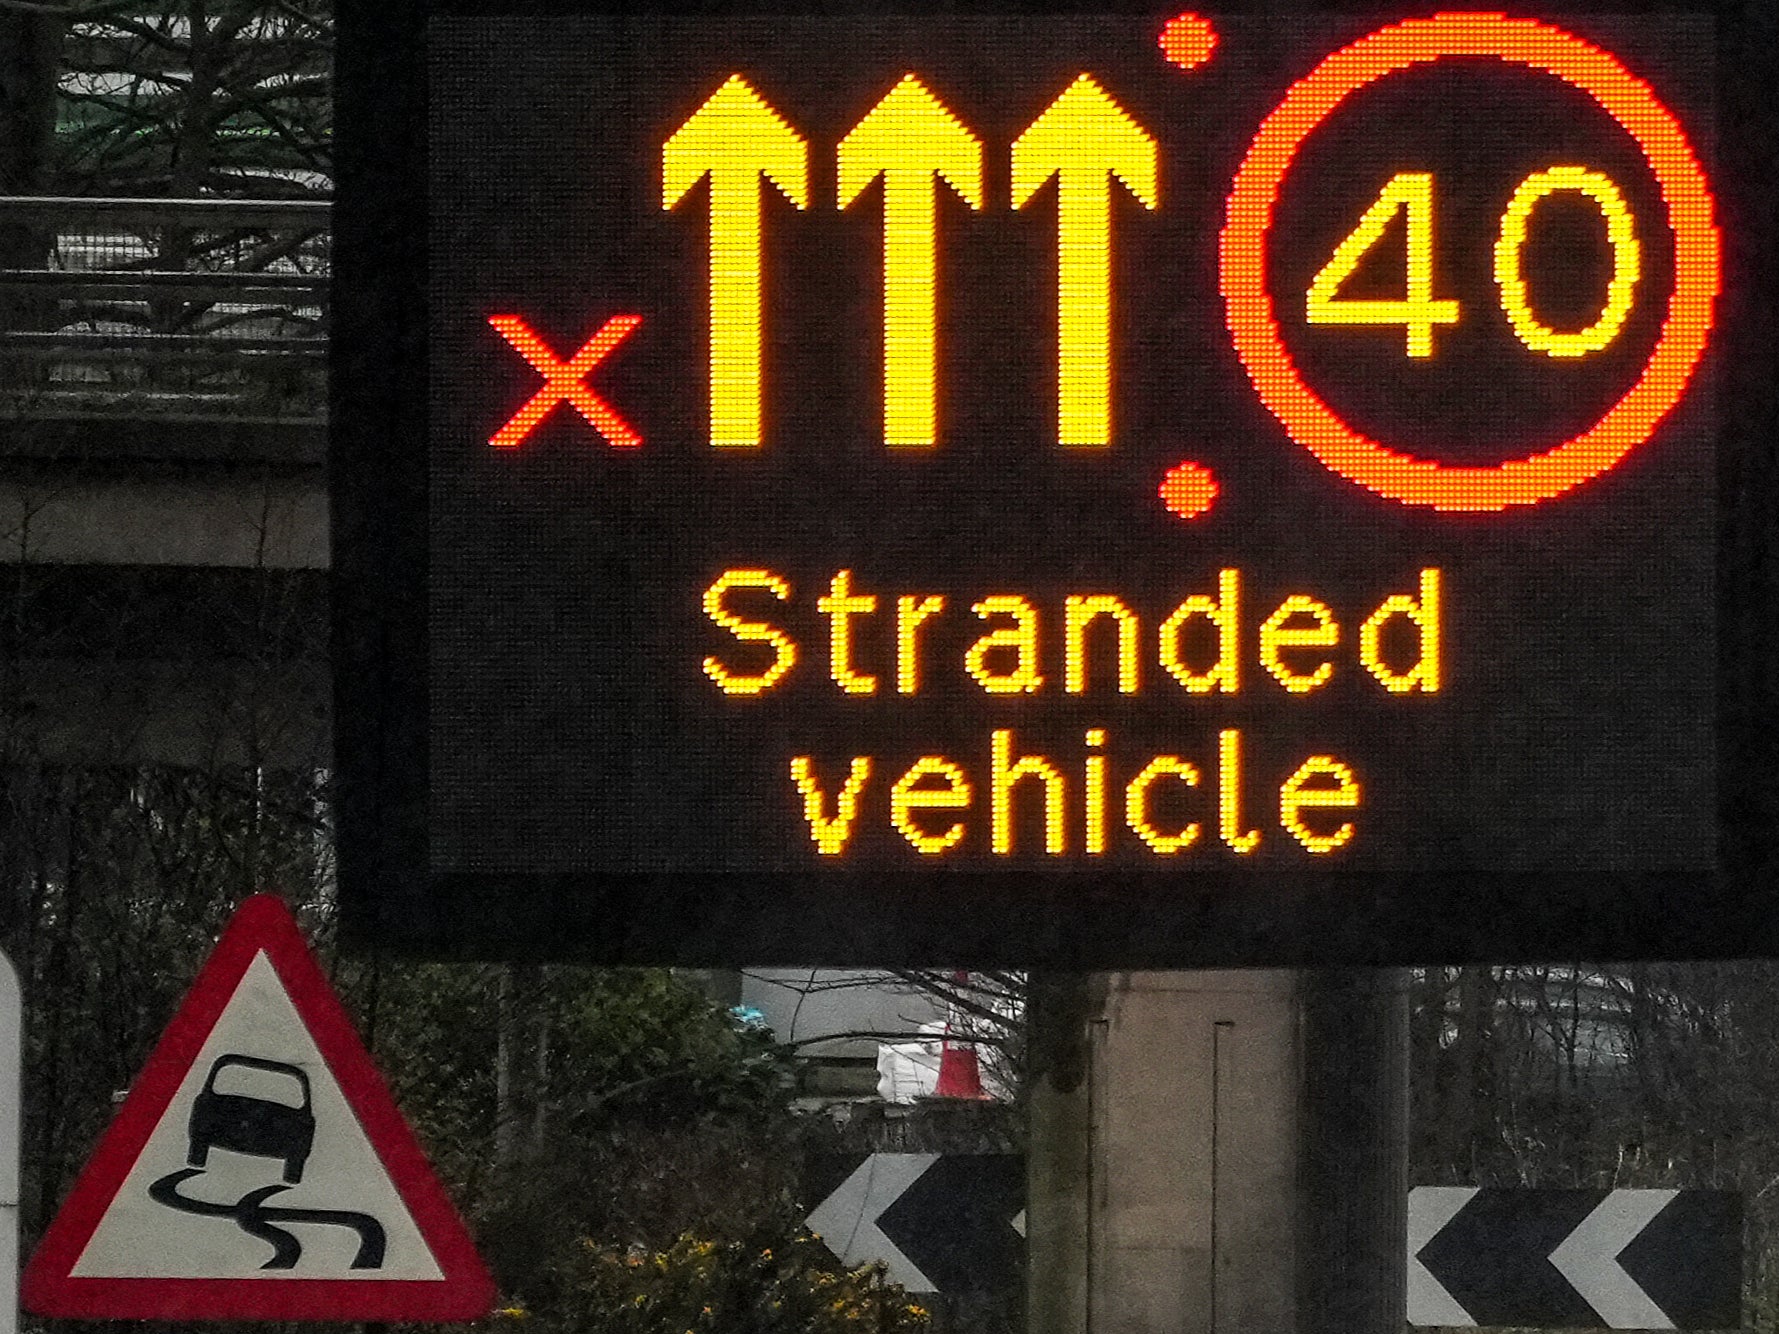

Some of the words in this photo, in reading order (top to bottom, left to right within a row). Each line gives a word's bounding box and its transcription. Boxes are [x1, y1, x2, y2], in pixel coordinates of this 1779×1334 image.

[1306, 166, 1640, 358] 40
[702, 568, 1442, 696] Stranded
[789, 729, 1363, 855] vehicle
